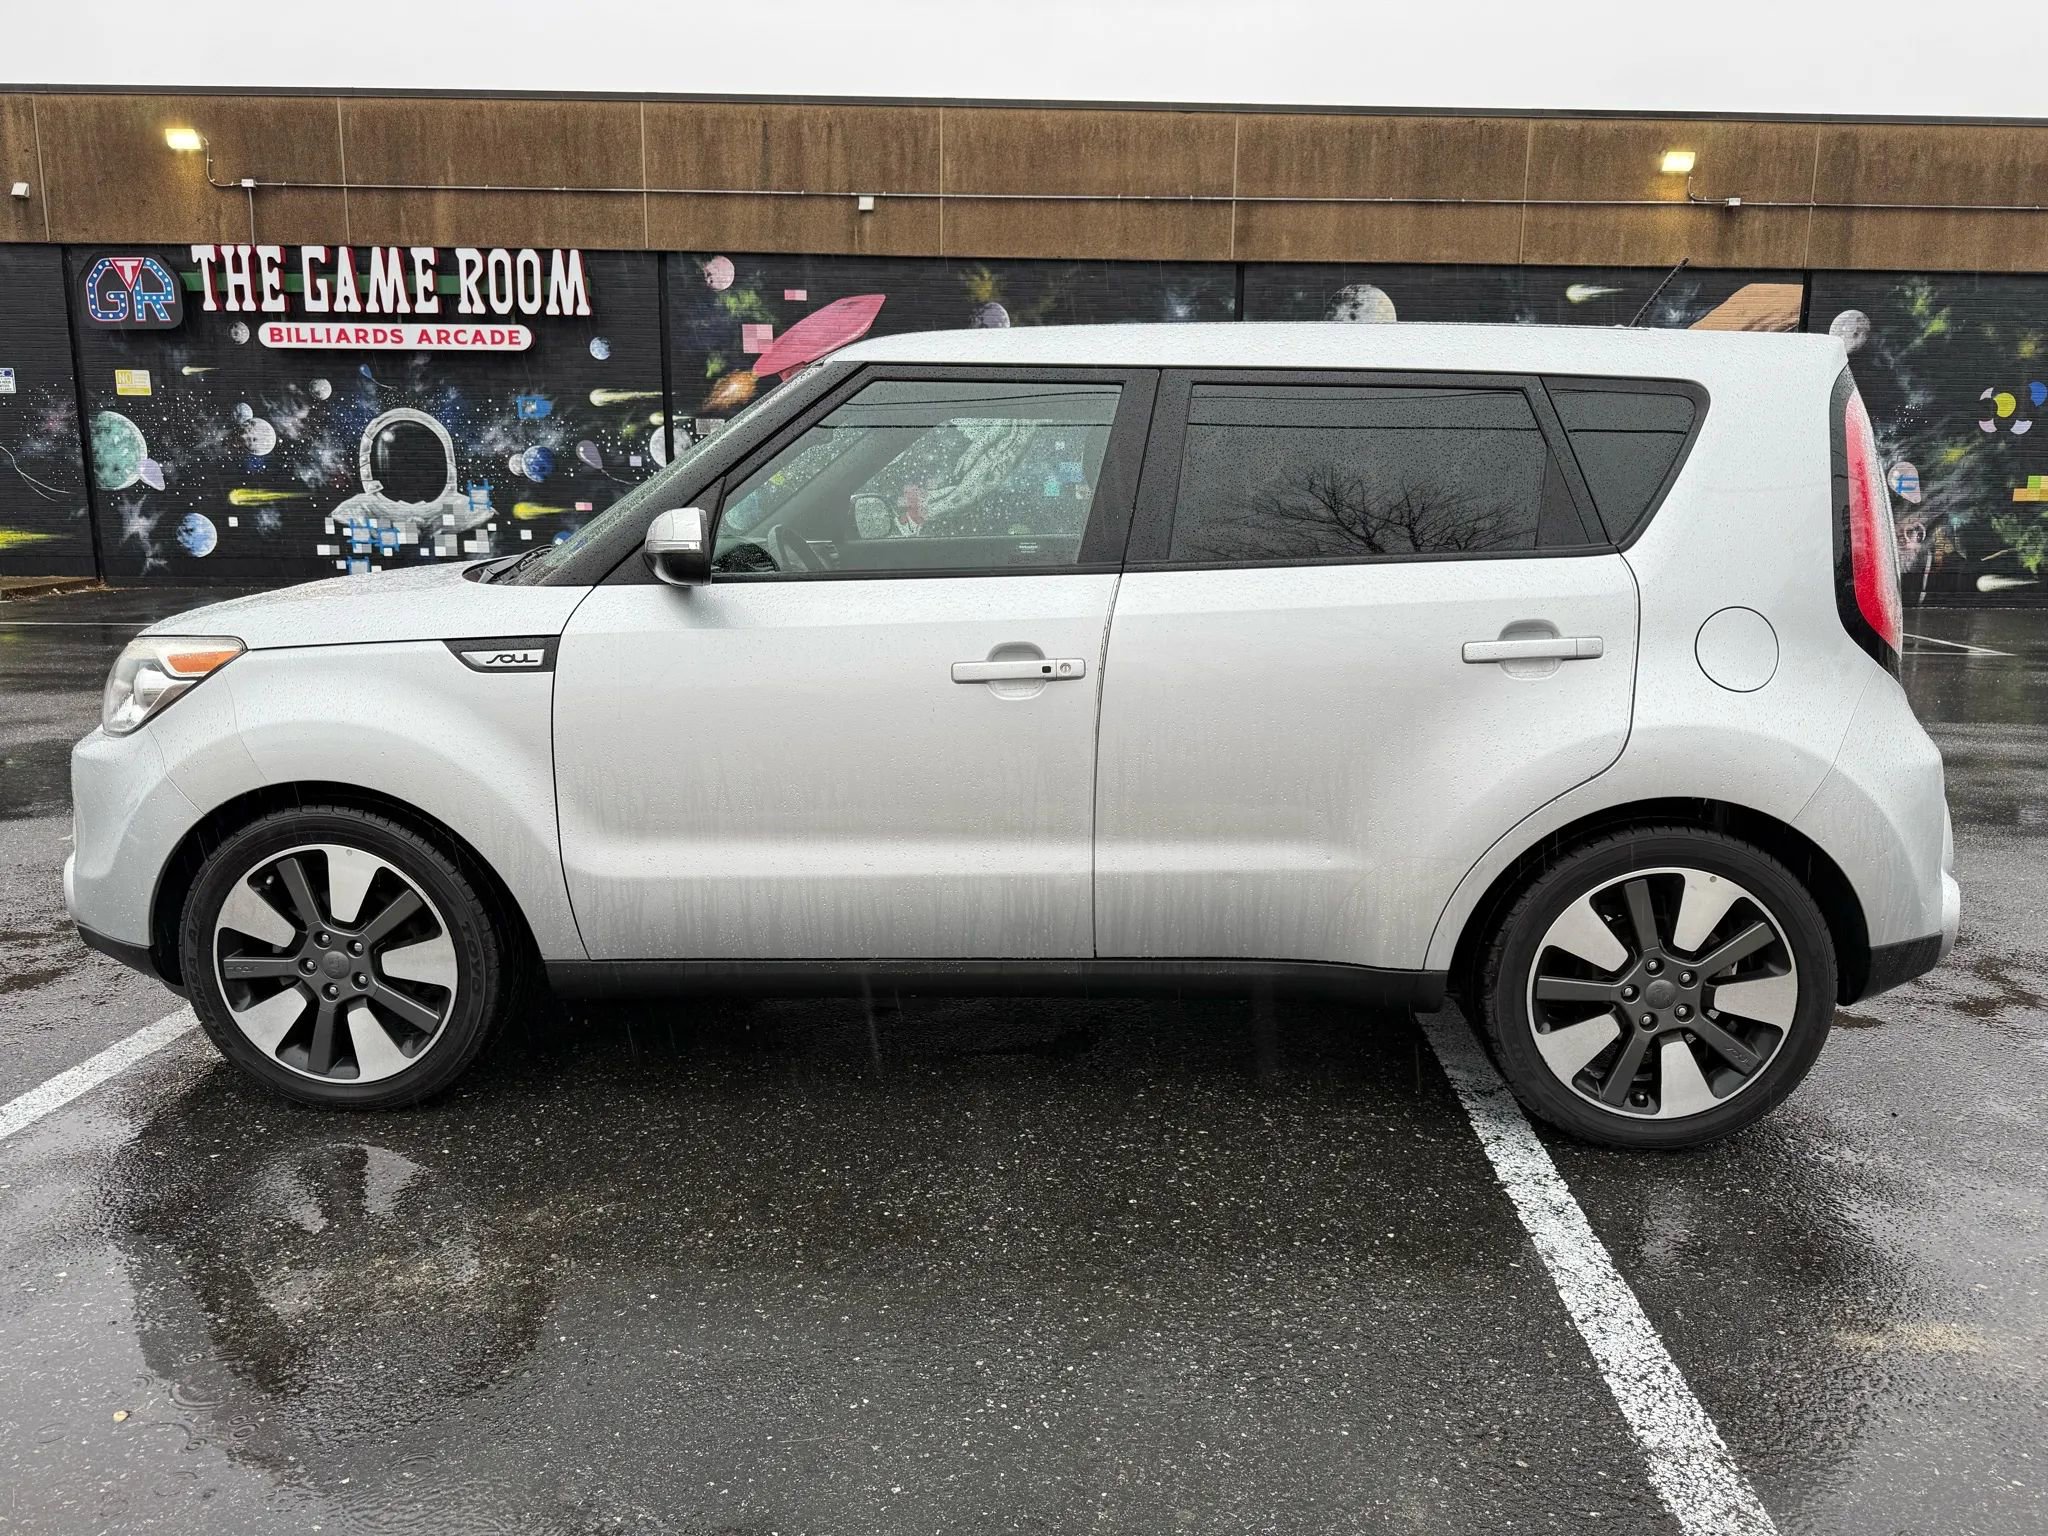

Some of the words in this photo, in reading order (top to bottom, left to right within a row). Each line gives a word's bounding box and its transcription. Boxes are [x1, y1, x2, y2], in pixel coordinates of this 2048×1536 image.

[190, 245, 284, 313] THE
[301, 245, 438, 315] GAME
[455, 248, 591, 316] ROOM
[268, 326, 405, 346] BILLIARDS
[417, 328, 522, 346] ARCADE
